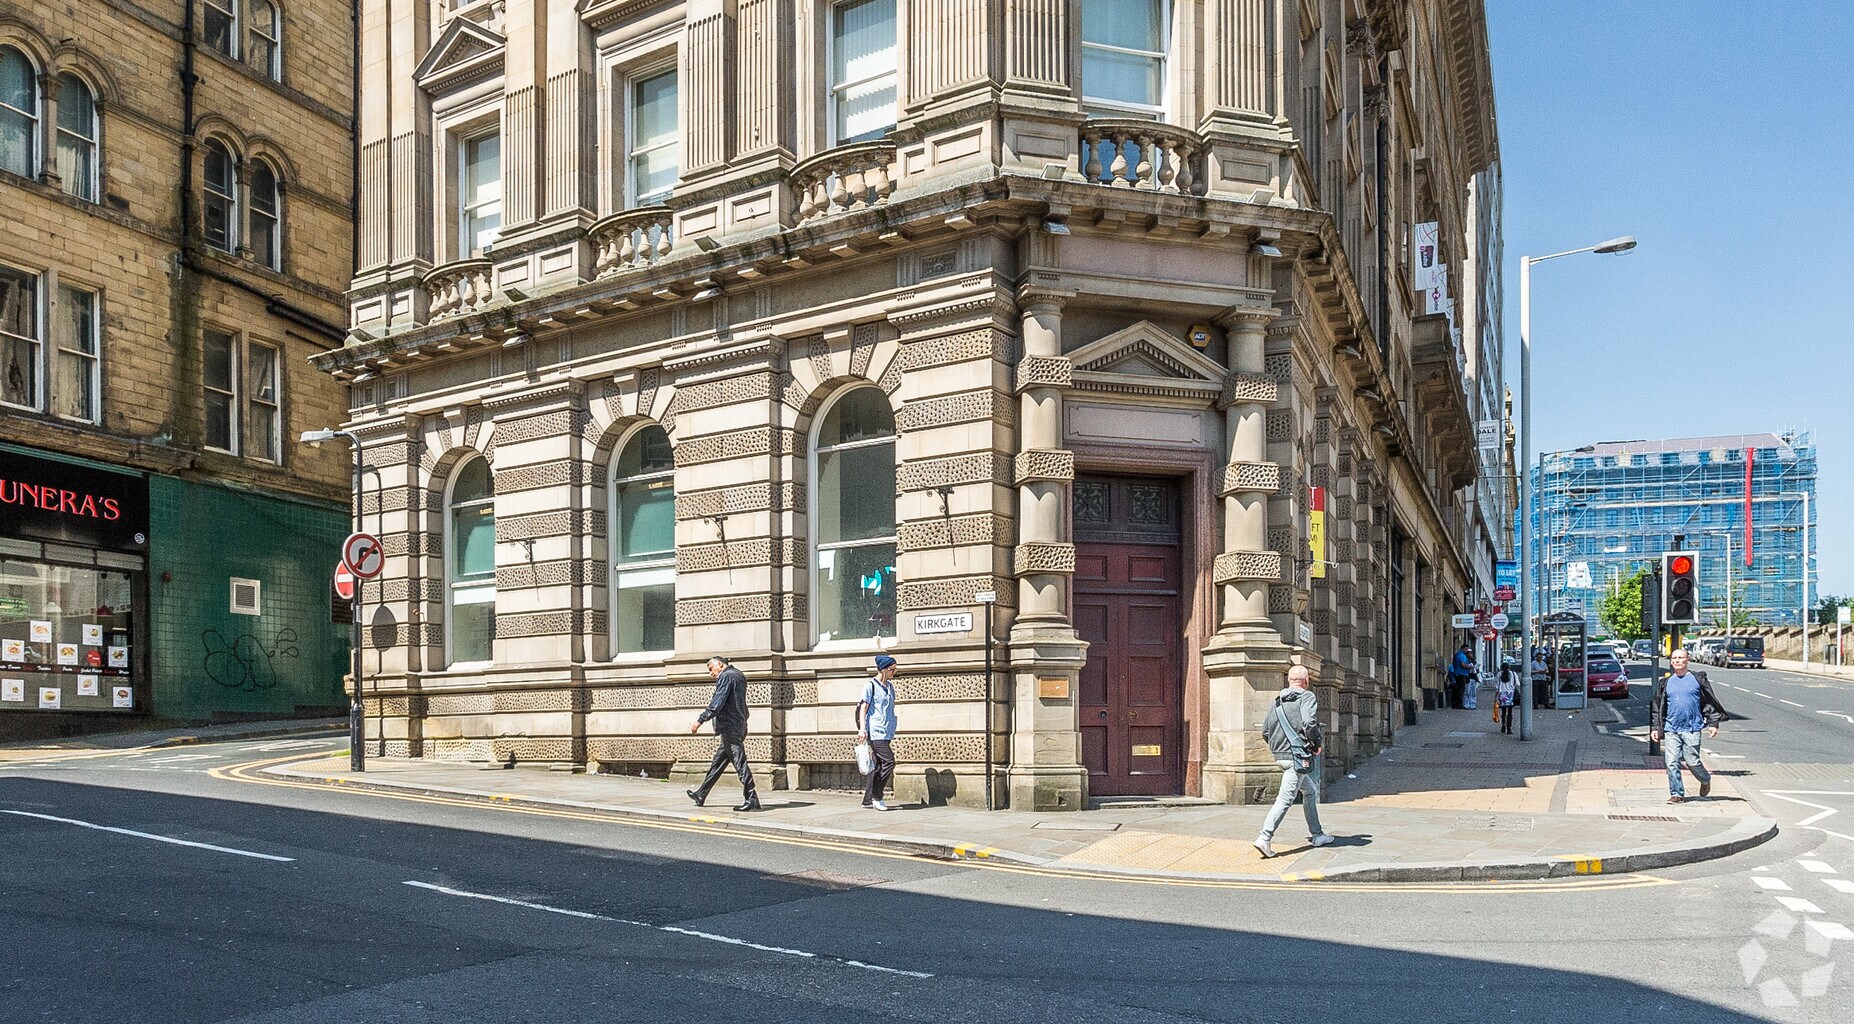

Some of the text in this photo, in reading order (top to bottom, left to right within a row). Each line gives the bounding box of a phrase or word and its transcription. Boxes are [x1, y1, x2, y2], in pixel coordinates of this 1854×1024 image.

[0, 479, 121, 520] UNERA'S
[1312, 523, 1320, 533] FT
[917, 617, 966, 629] KIRKGATE
